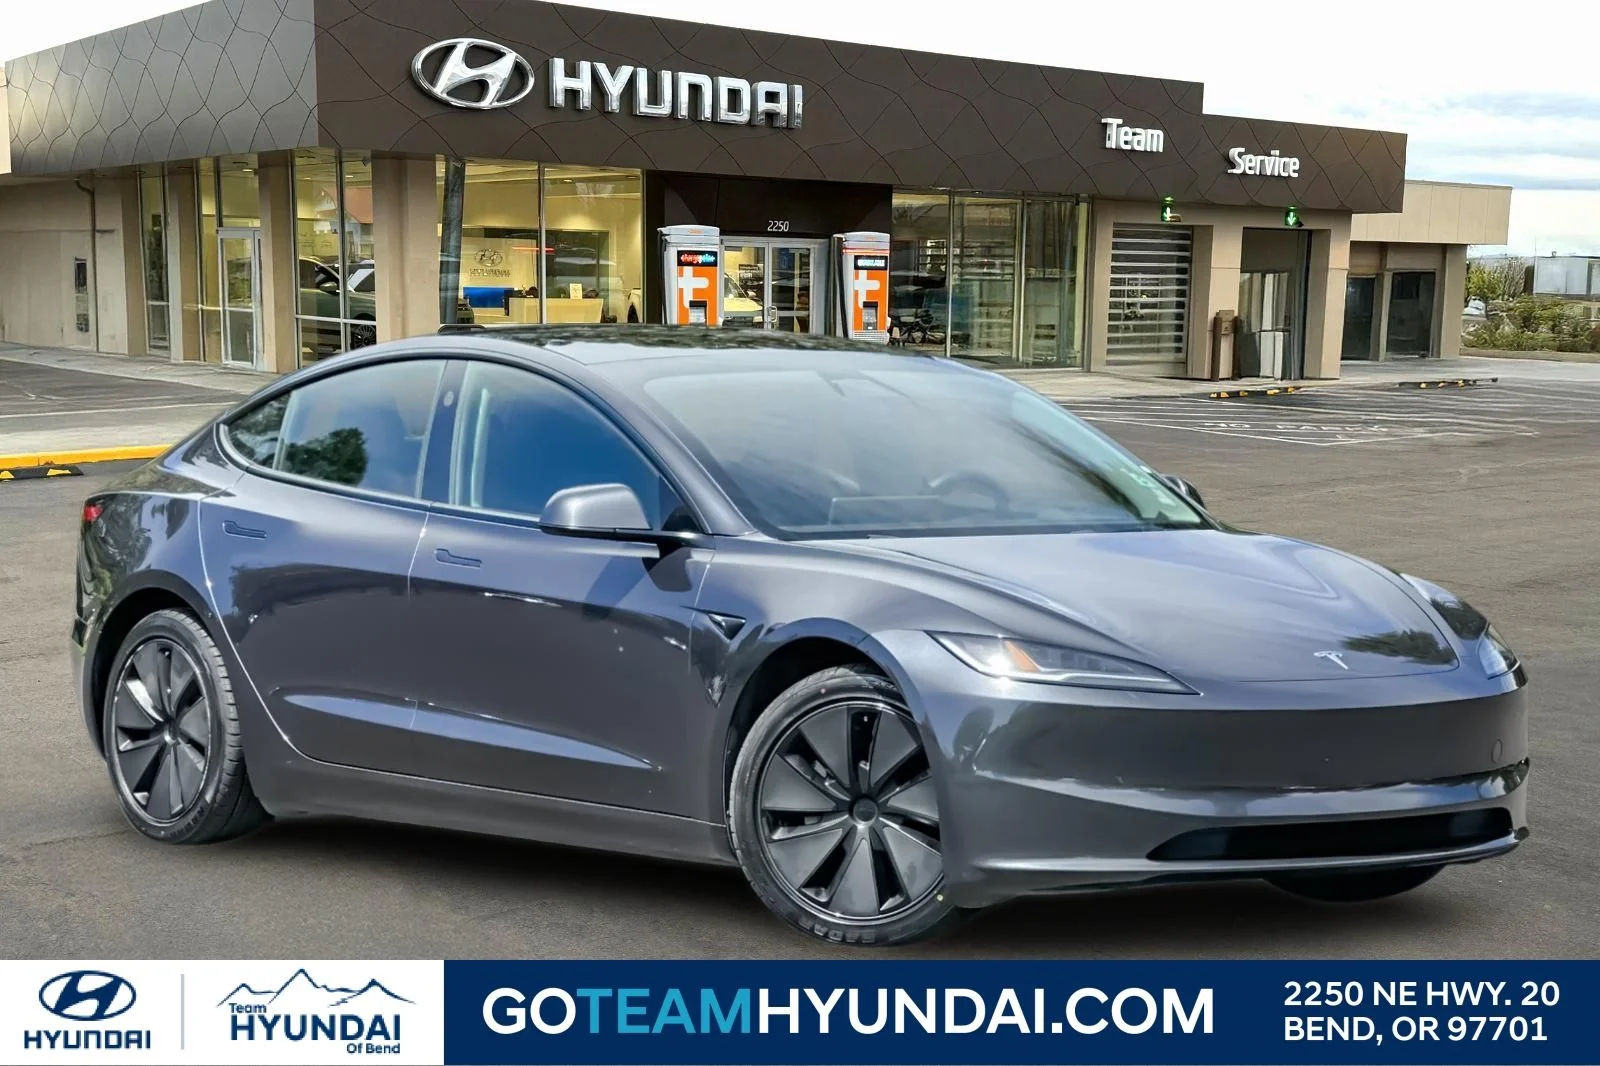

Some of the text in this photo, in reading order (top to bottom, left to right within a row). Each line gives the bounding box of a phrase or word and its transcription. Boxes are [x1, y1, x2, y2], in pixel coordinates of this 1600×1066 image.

[549, 57, 803, 129] HYUNDAI
[1101, 118, 1164, 152] Team
[1228, 147, 1300, 177] Service
[767, 220, 790, 232] 2250
